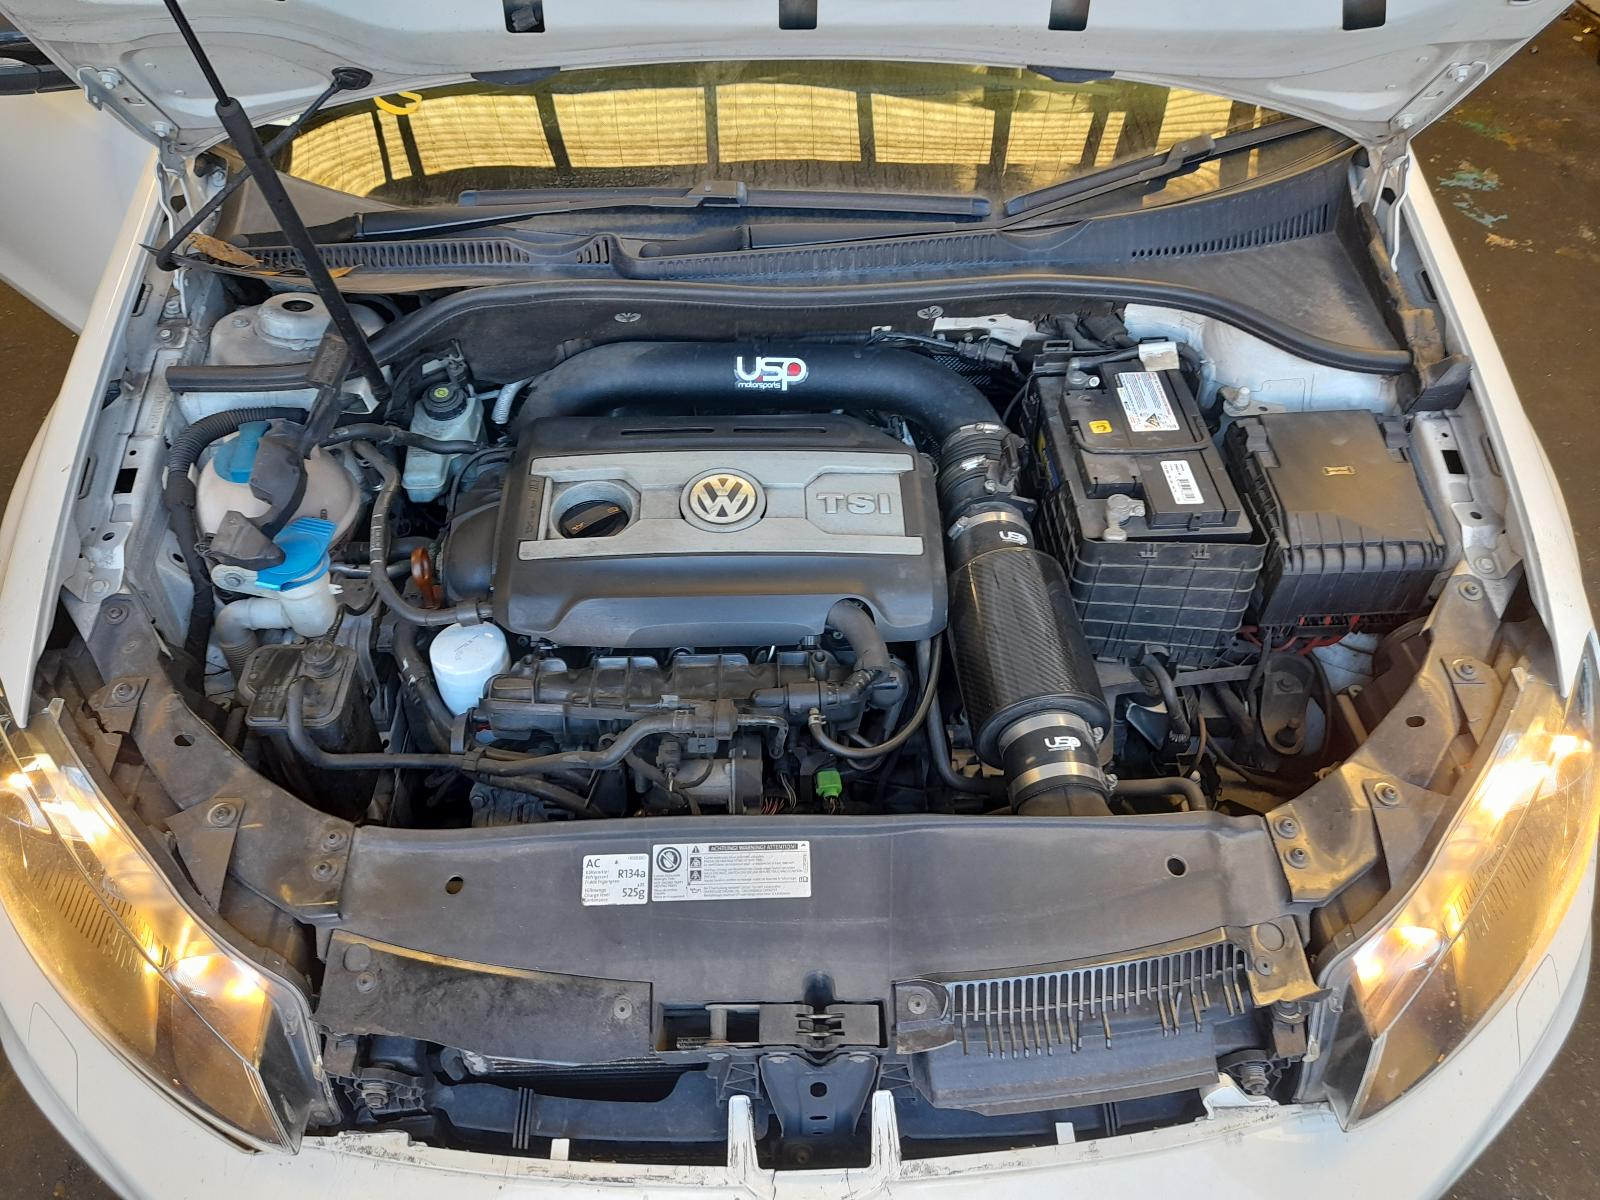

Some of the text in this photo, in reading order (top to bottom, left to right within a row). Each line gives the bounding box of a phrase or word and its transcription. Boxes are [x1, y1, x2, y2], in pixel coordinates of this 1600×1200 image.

[737, 380, 782, 390] motorsports
[816, 492, 892, 515] TSI
[586, 858, 601, 868] AC
[618, 868, 646, 879] R134a
[622, 887, 645, 900] 525g
